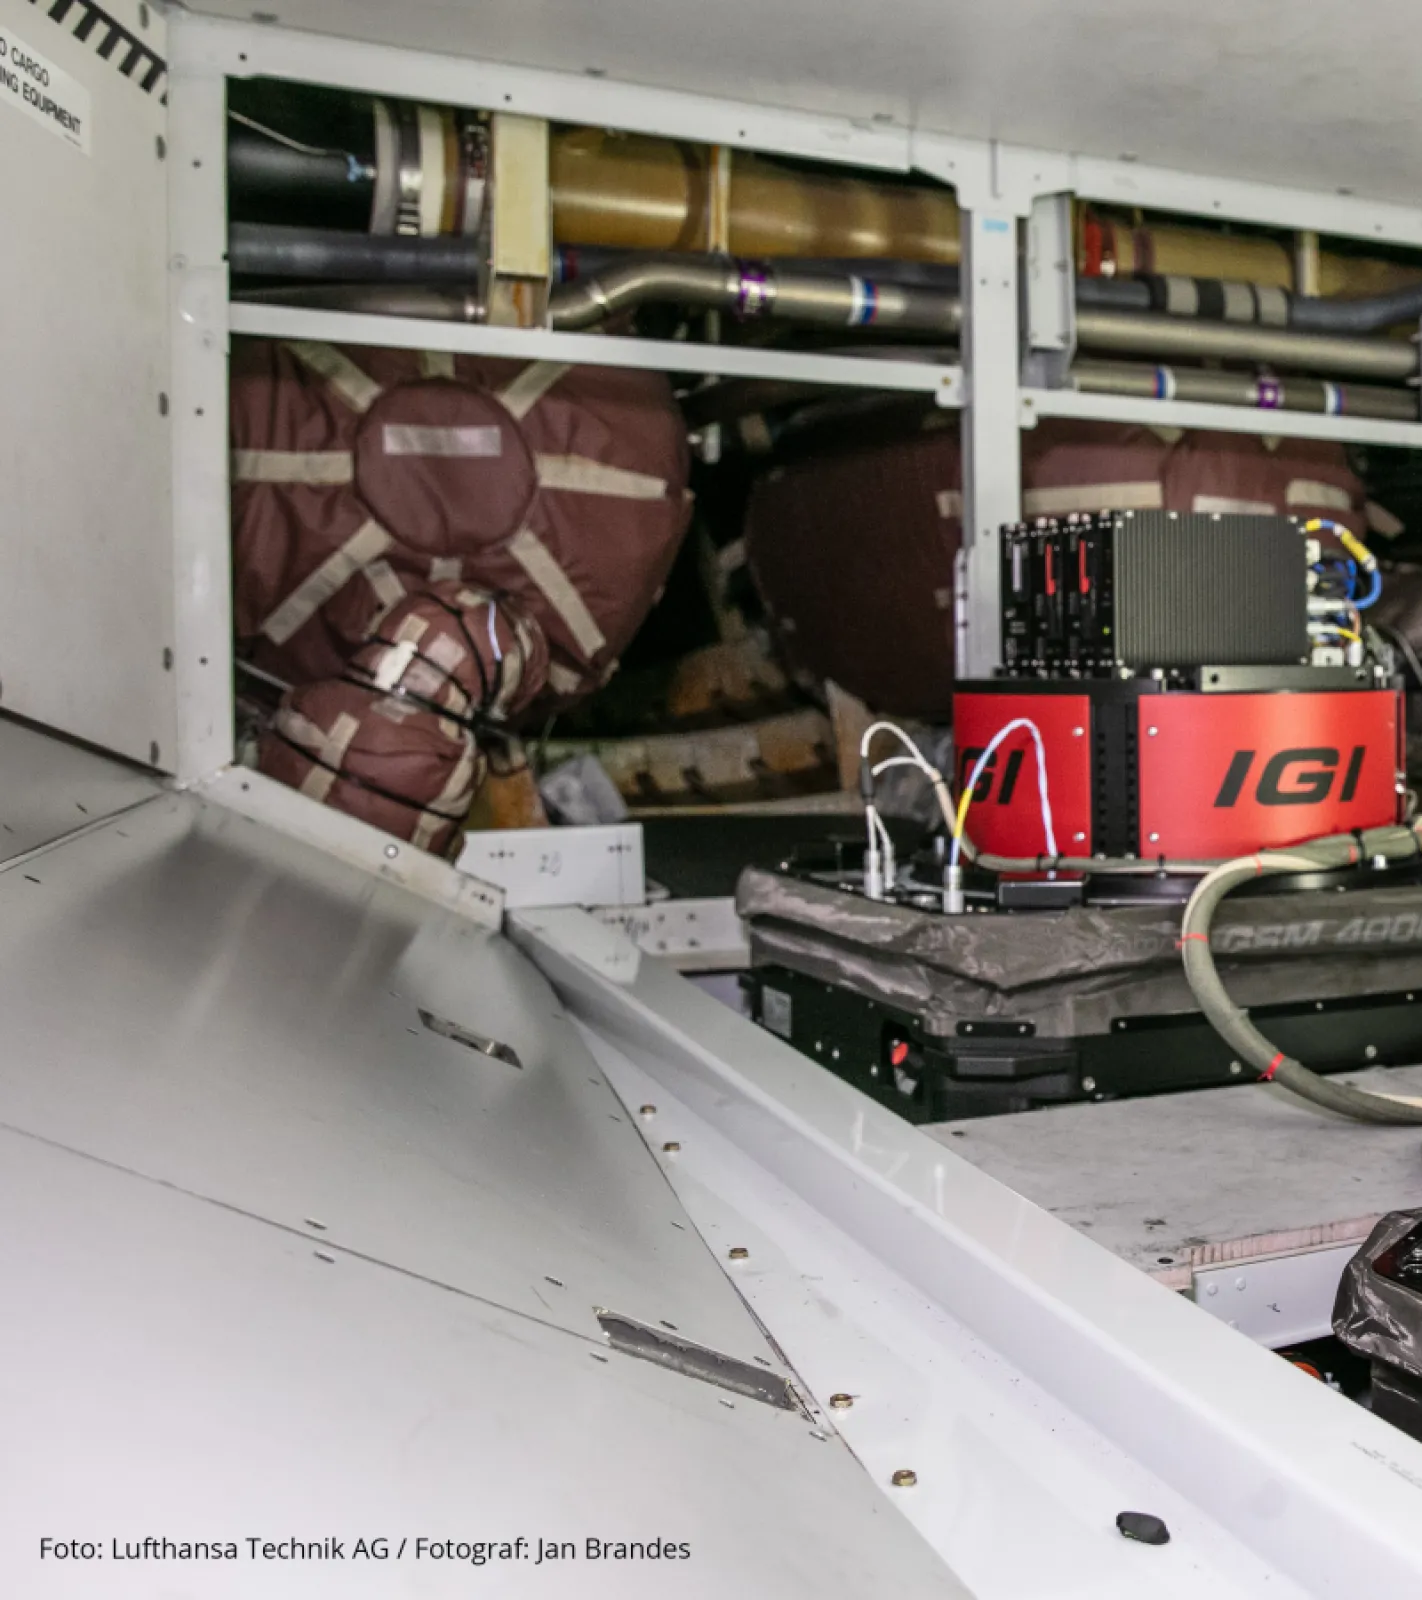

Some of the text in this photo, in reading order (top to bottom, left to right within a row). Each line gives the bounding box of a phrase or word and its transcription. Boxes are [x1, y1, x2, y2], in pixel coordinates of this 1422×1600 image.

[10, 45, 50, 87] CARGO
[22, 80, 82, 136] EQUIPMENT
[1213, 744, 1367, 808] IGI
